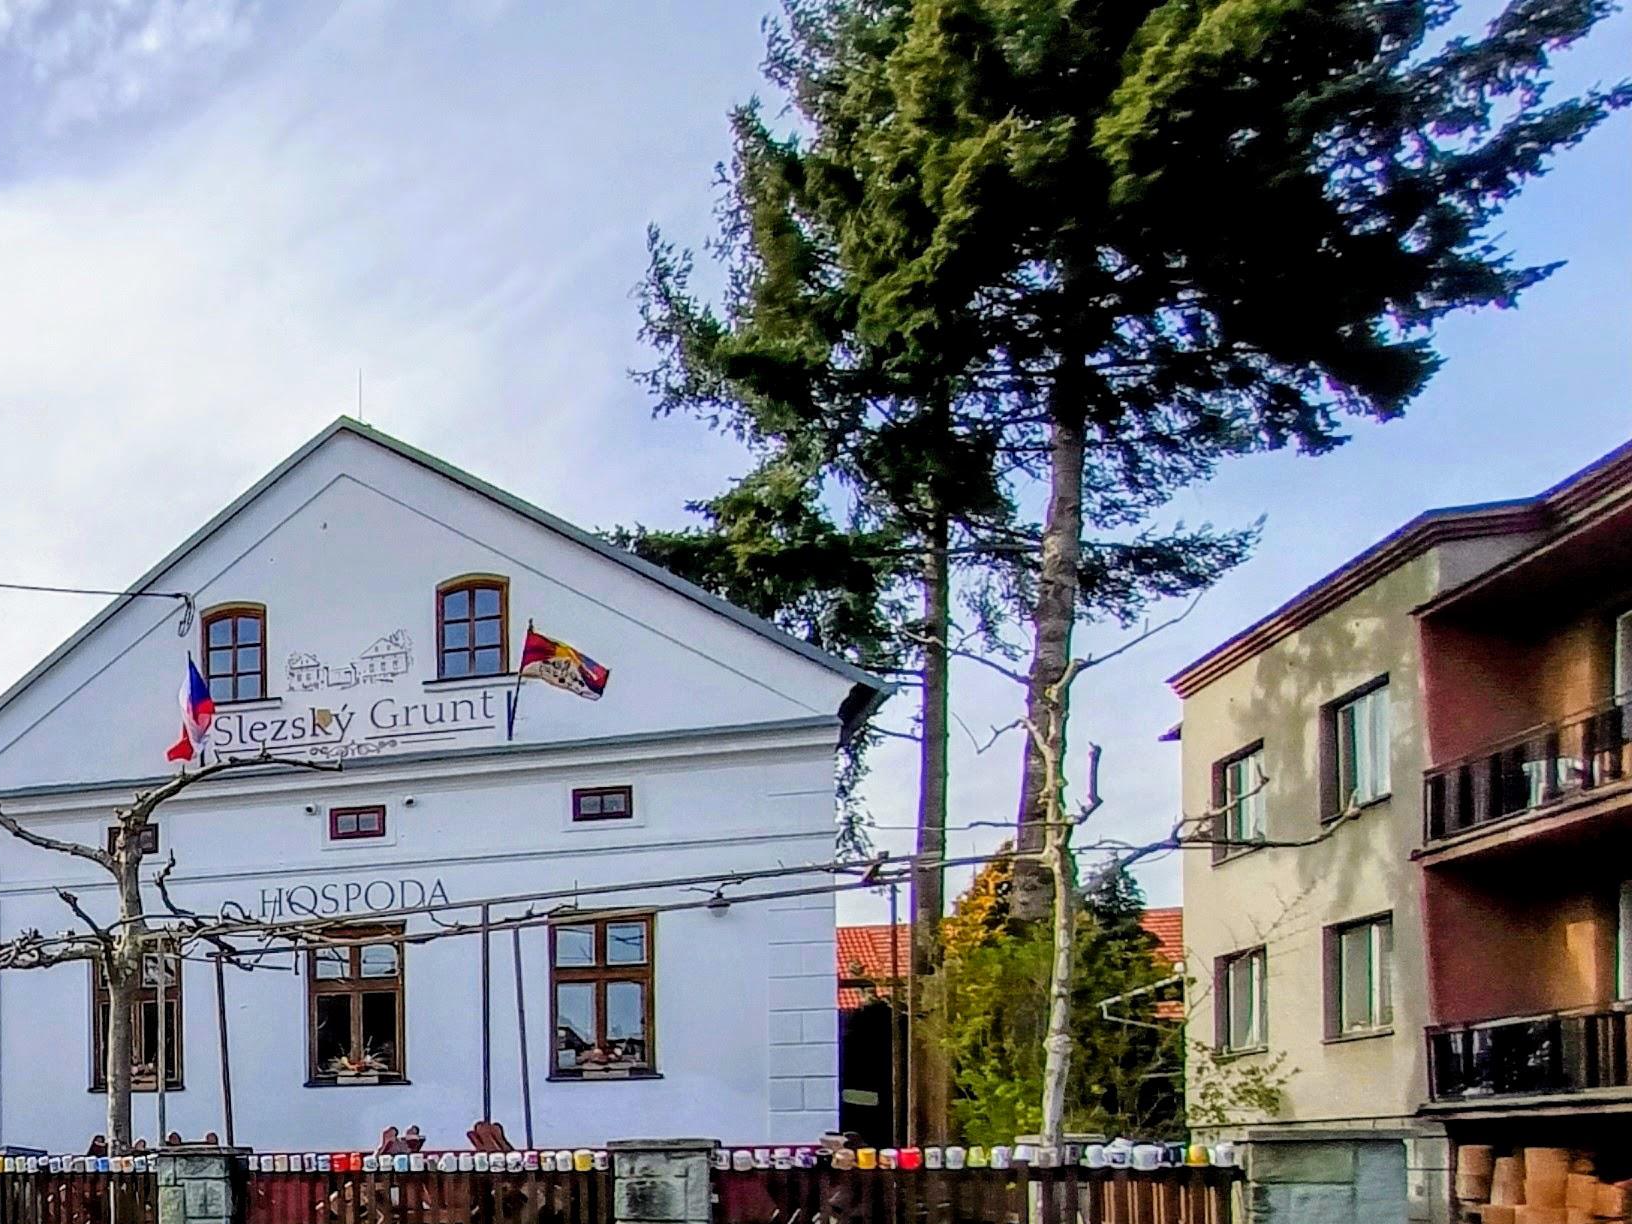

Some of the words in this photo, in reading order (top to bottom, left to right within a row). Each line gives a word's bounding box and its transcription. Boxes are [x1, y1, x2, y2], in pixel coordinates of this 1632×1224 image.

[214, 703, 355, 746] Slezský
[370, 690, 495, 730] Grunt
[258, 878, 450, 917] HOSPODA
